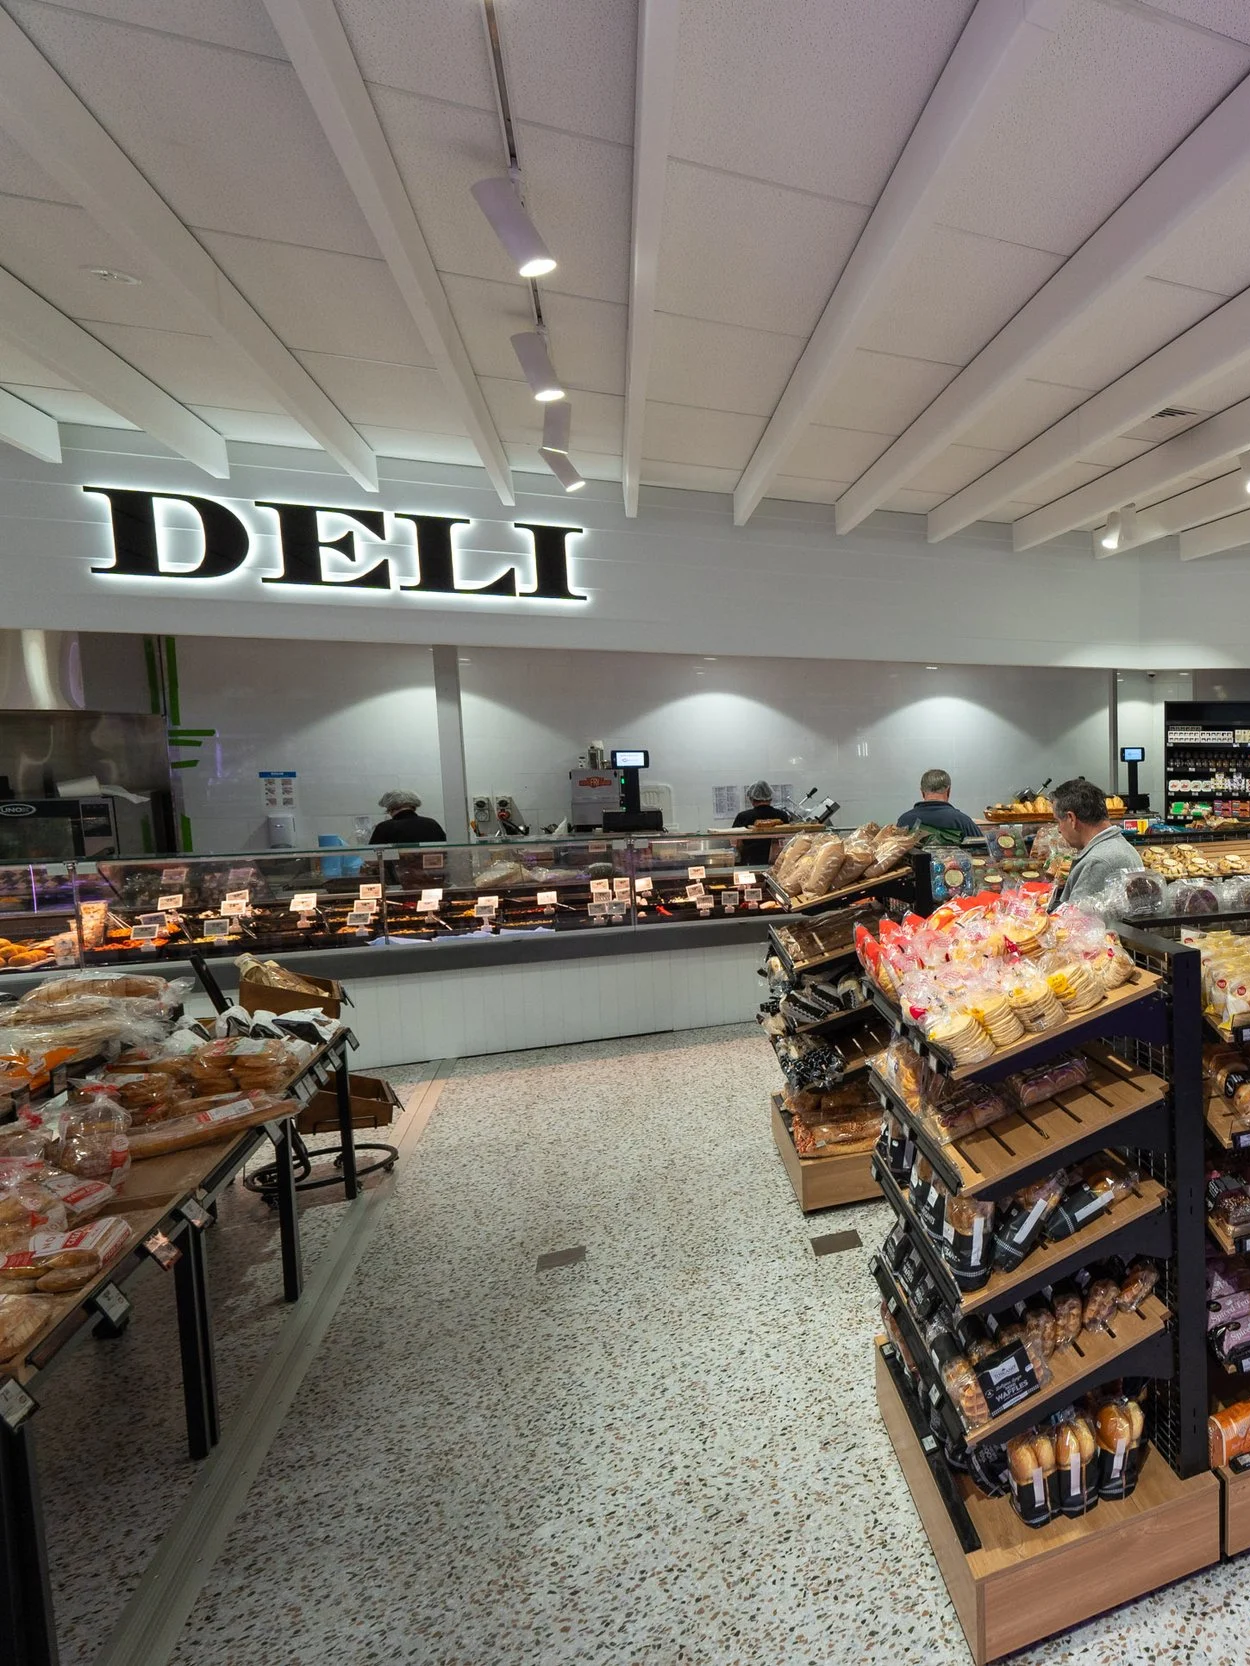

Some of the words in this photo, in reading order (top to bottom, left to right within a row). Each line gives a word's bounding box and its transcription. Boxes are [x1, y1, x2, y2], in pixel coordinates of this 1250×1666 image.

[83, 485, 588, 602] DELI
[1210, 1306, 1236, 1323] Spiced
[995, 1379, 1029, 1402] WAFFLES
